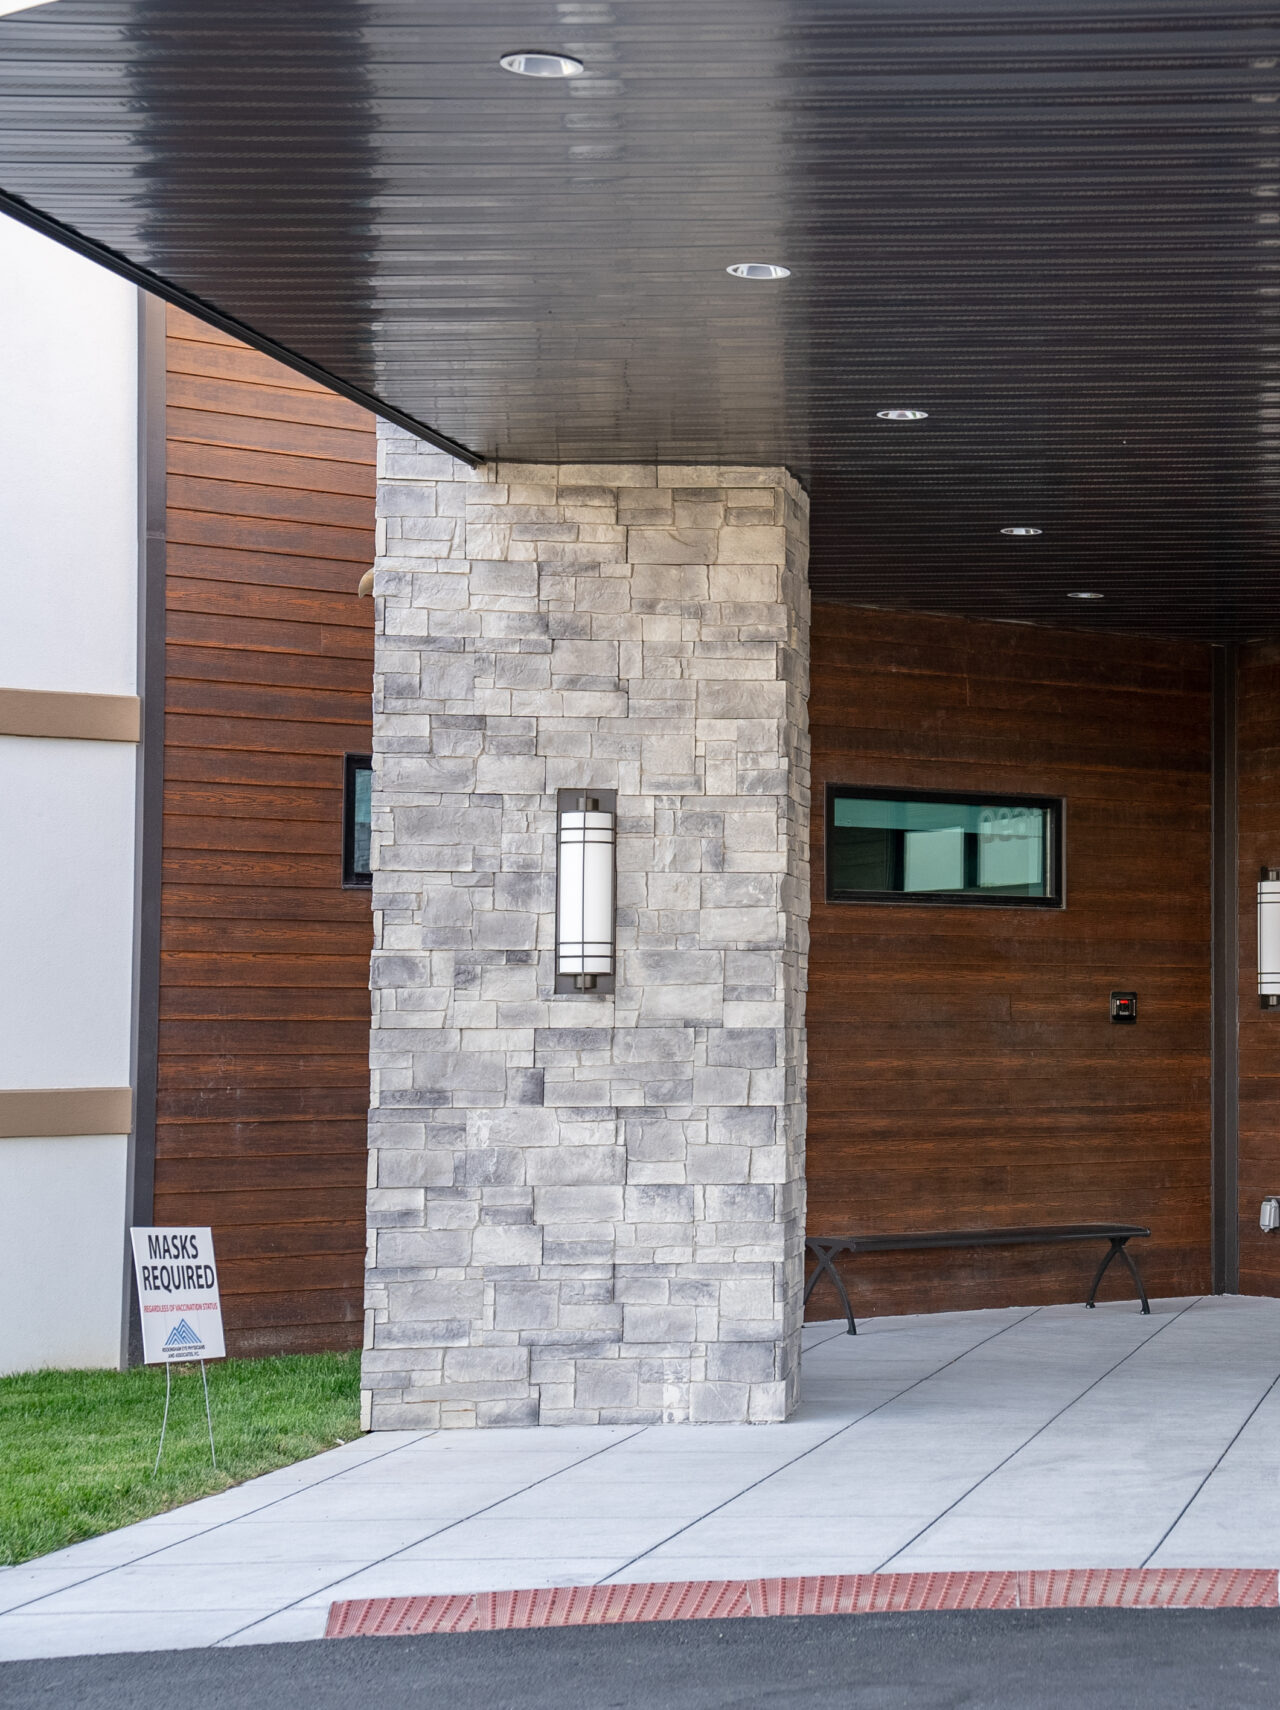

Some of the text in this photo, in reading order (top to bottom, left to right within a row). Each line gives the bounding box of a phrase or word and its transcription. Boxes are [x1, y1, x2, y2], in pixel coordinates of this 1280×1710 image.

[148, 1235, 198, 1259] MASKS
[142, 1265, 215, 1293] REQUIRED
[144, 1302, 218, 1313] REGARDLESS OF VACCINATION STATUS
